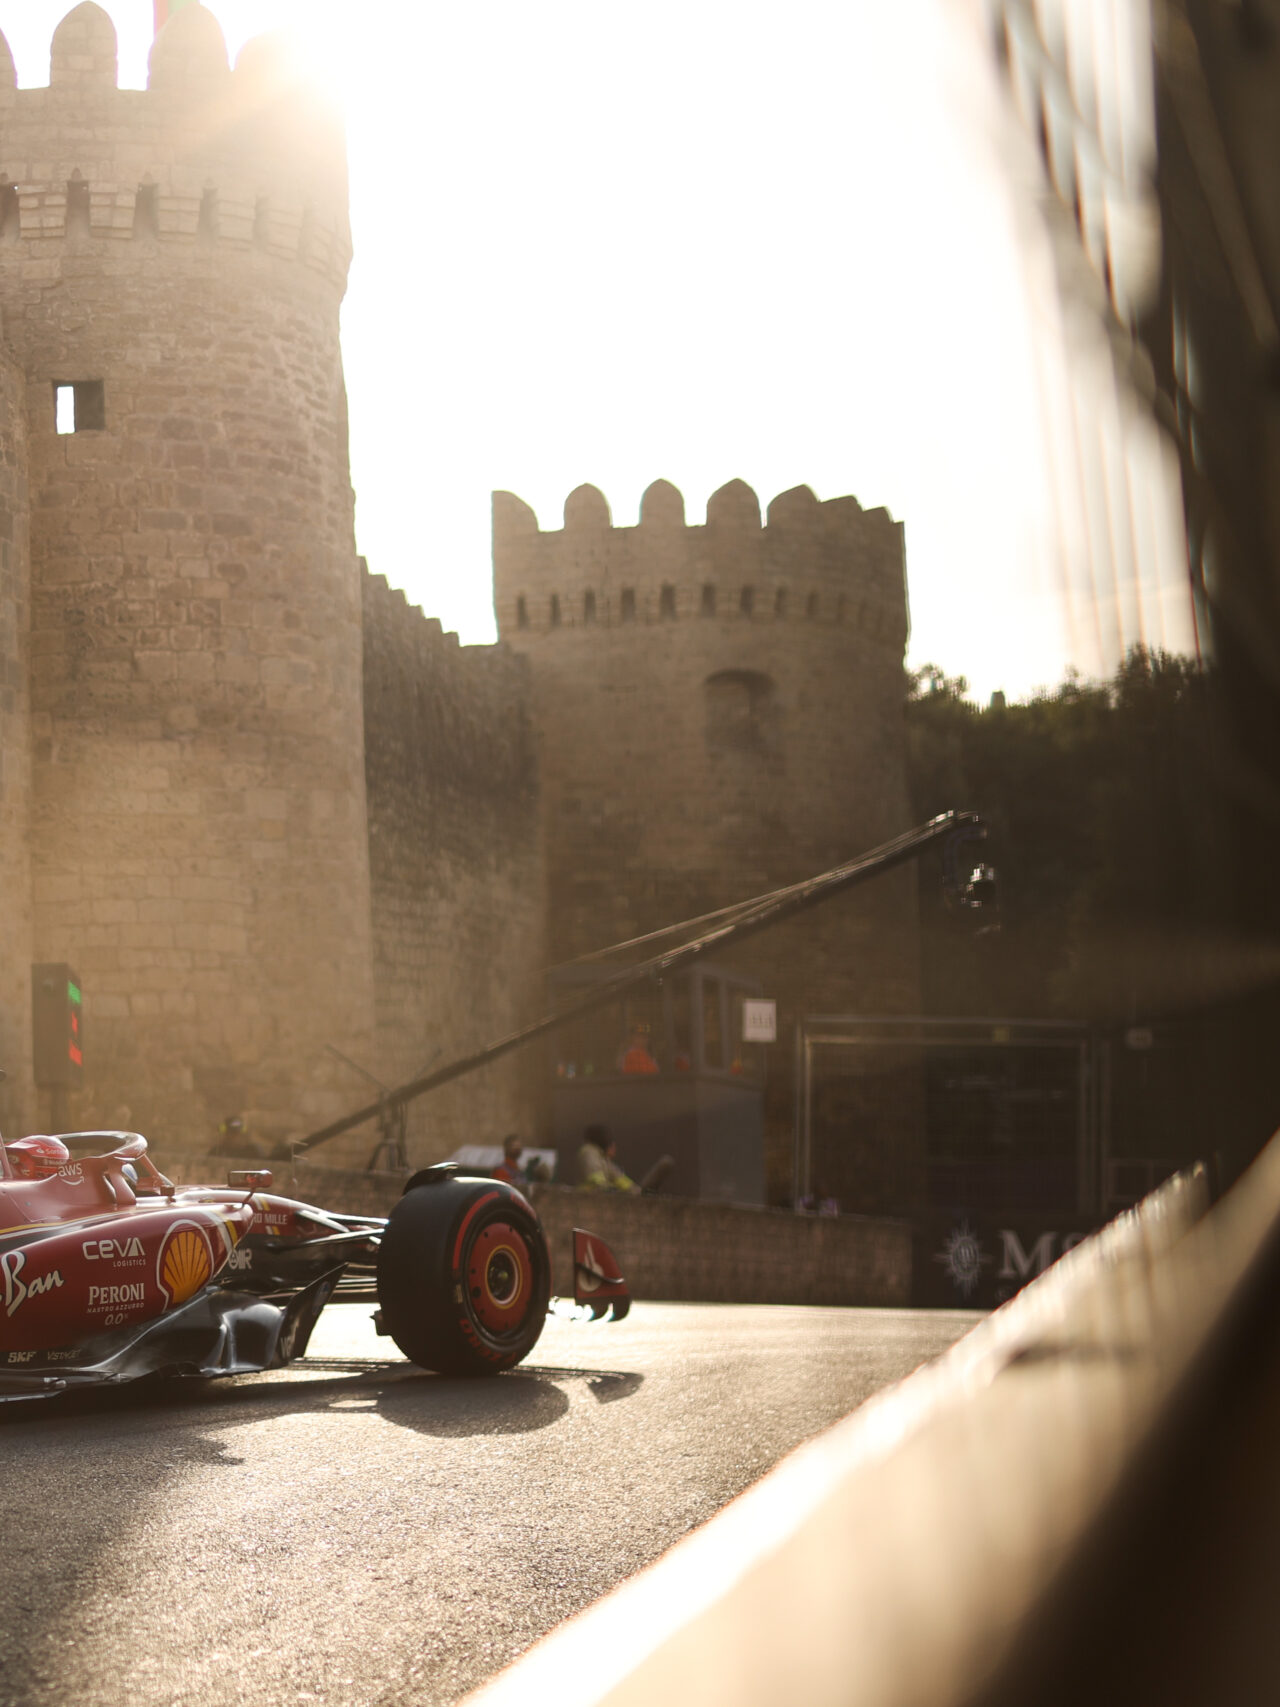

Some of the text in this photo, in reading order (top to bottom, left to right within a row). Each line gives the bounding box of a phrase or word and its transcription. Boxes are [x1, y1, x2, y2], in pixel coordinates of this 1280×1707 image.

[58, 1163, 83, 1177] aws
[113, 1259, 146, 1268] LOGISTICS
[88, 1282, 145, 1306] PERONI
[8, 1351, 37, 1363] SKF
